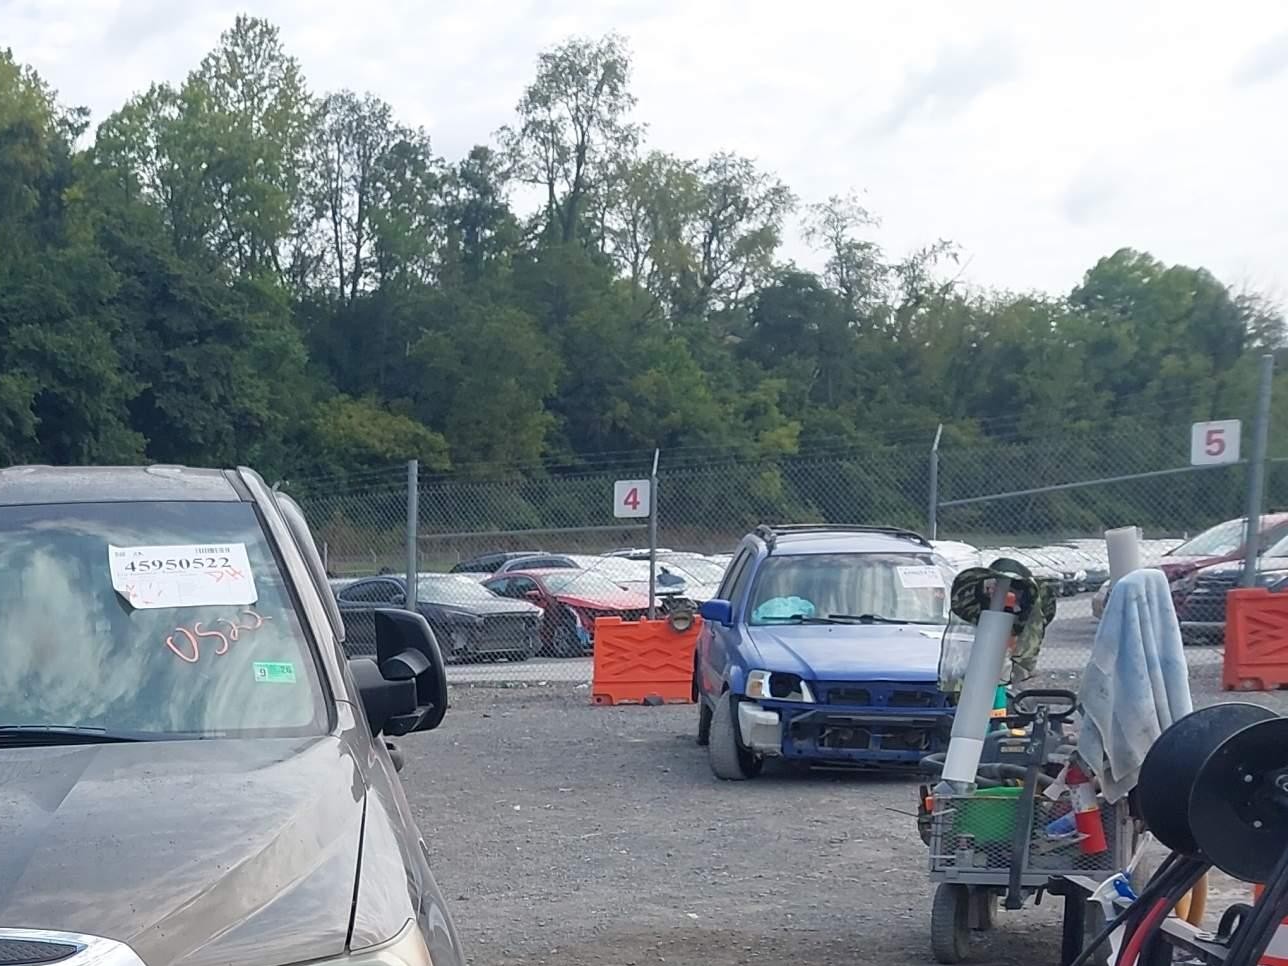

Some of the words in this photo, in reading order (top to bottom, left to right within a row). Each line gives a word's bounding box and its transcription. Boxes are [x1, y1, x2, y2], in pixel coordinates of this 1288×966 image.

[1205, 428, 1226, 456] 5
[623, 487, 641, 510] 4
[124, 557, 232, 573] 45950522
